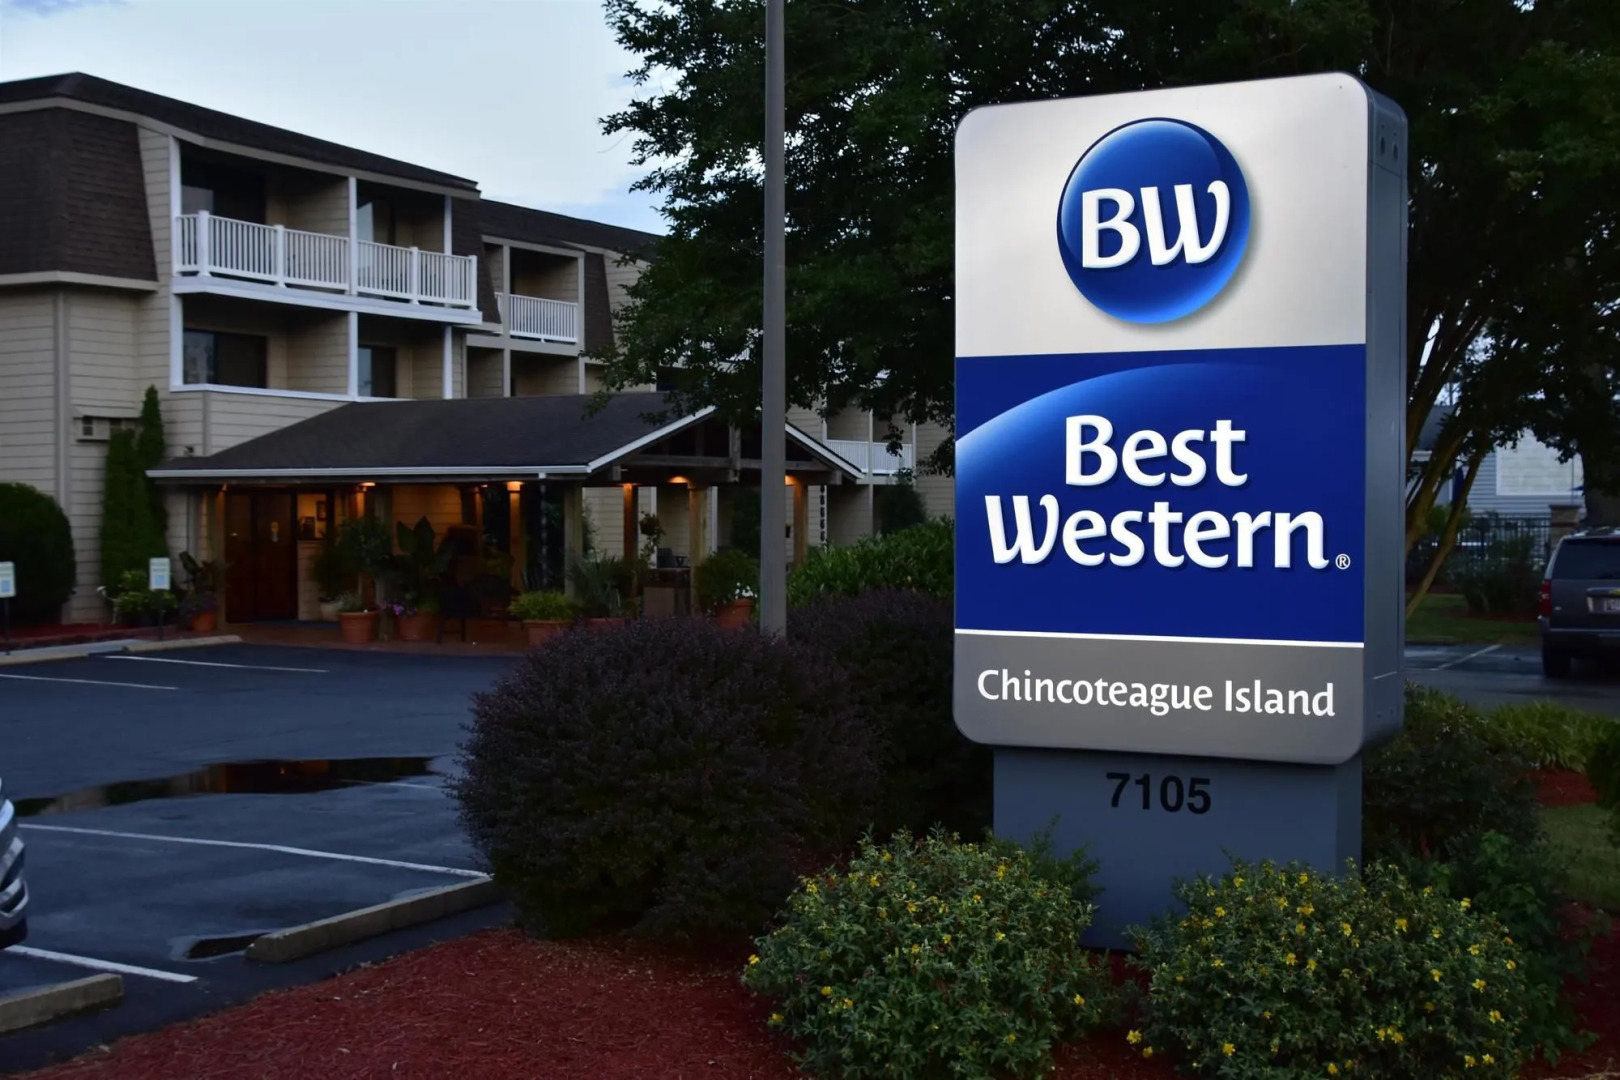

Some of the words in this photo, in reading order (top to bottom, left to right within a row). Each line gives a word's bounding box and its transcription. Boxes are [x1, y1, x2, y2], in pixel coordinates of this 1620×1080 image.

[1082, 180, 1231, 269] BW
[1065, 414, 1248, 487] Best
[984, 494, 1329, 569] Western
[977, 668, 1213, 717] Chincoteague
[1225, 679, 1336, 717] Island
[1105, 771, 1212, 815] 7105
